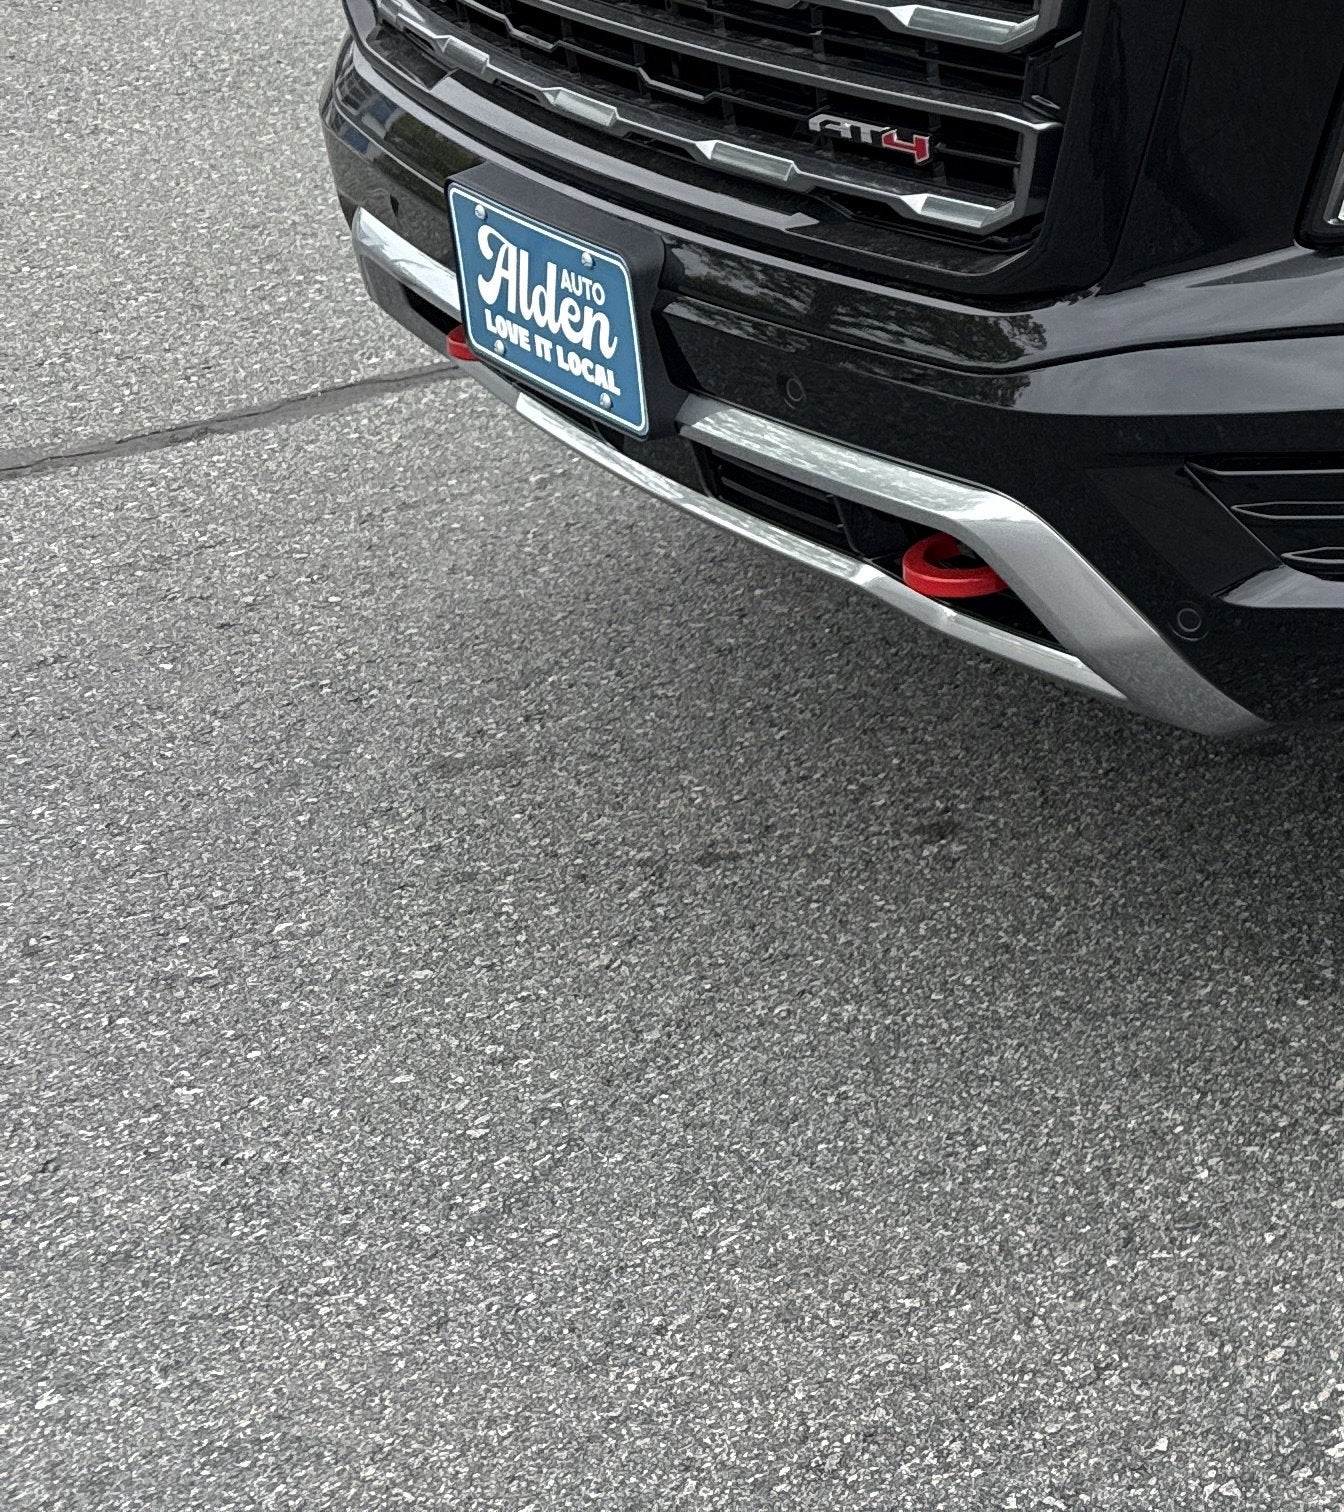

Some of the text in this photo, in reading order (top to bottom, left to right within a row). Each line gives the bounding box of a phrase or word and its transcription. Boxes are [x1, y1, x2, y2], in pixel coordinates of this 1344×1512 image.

[808, 113, 931, 165] AT4
[477, 224, 618, 359] Alden
[561, 268, 606, 306] AUTO
[484, 308, 621, 396] LOVE IT LOCAL
